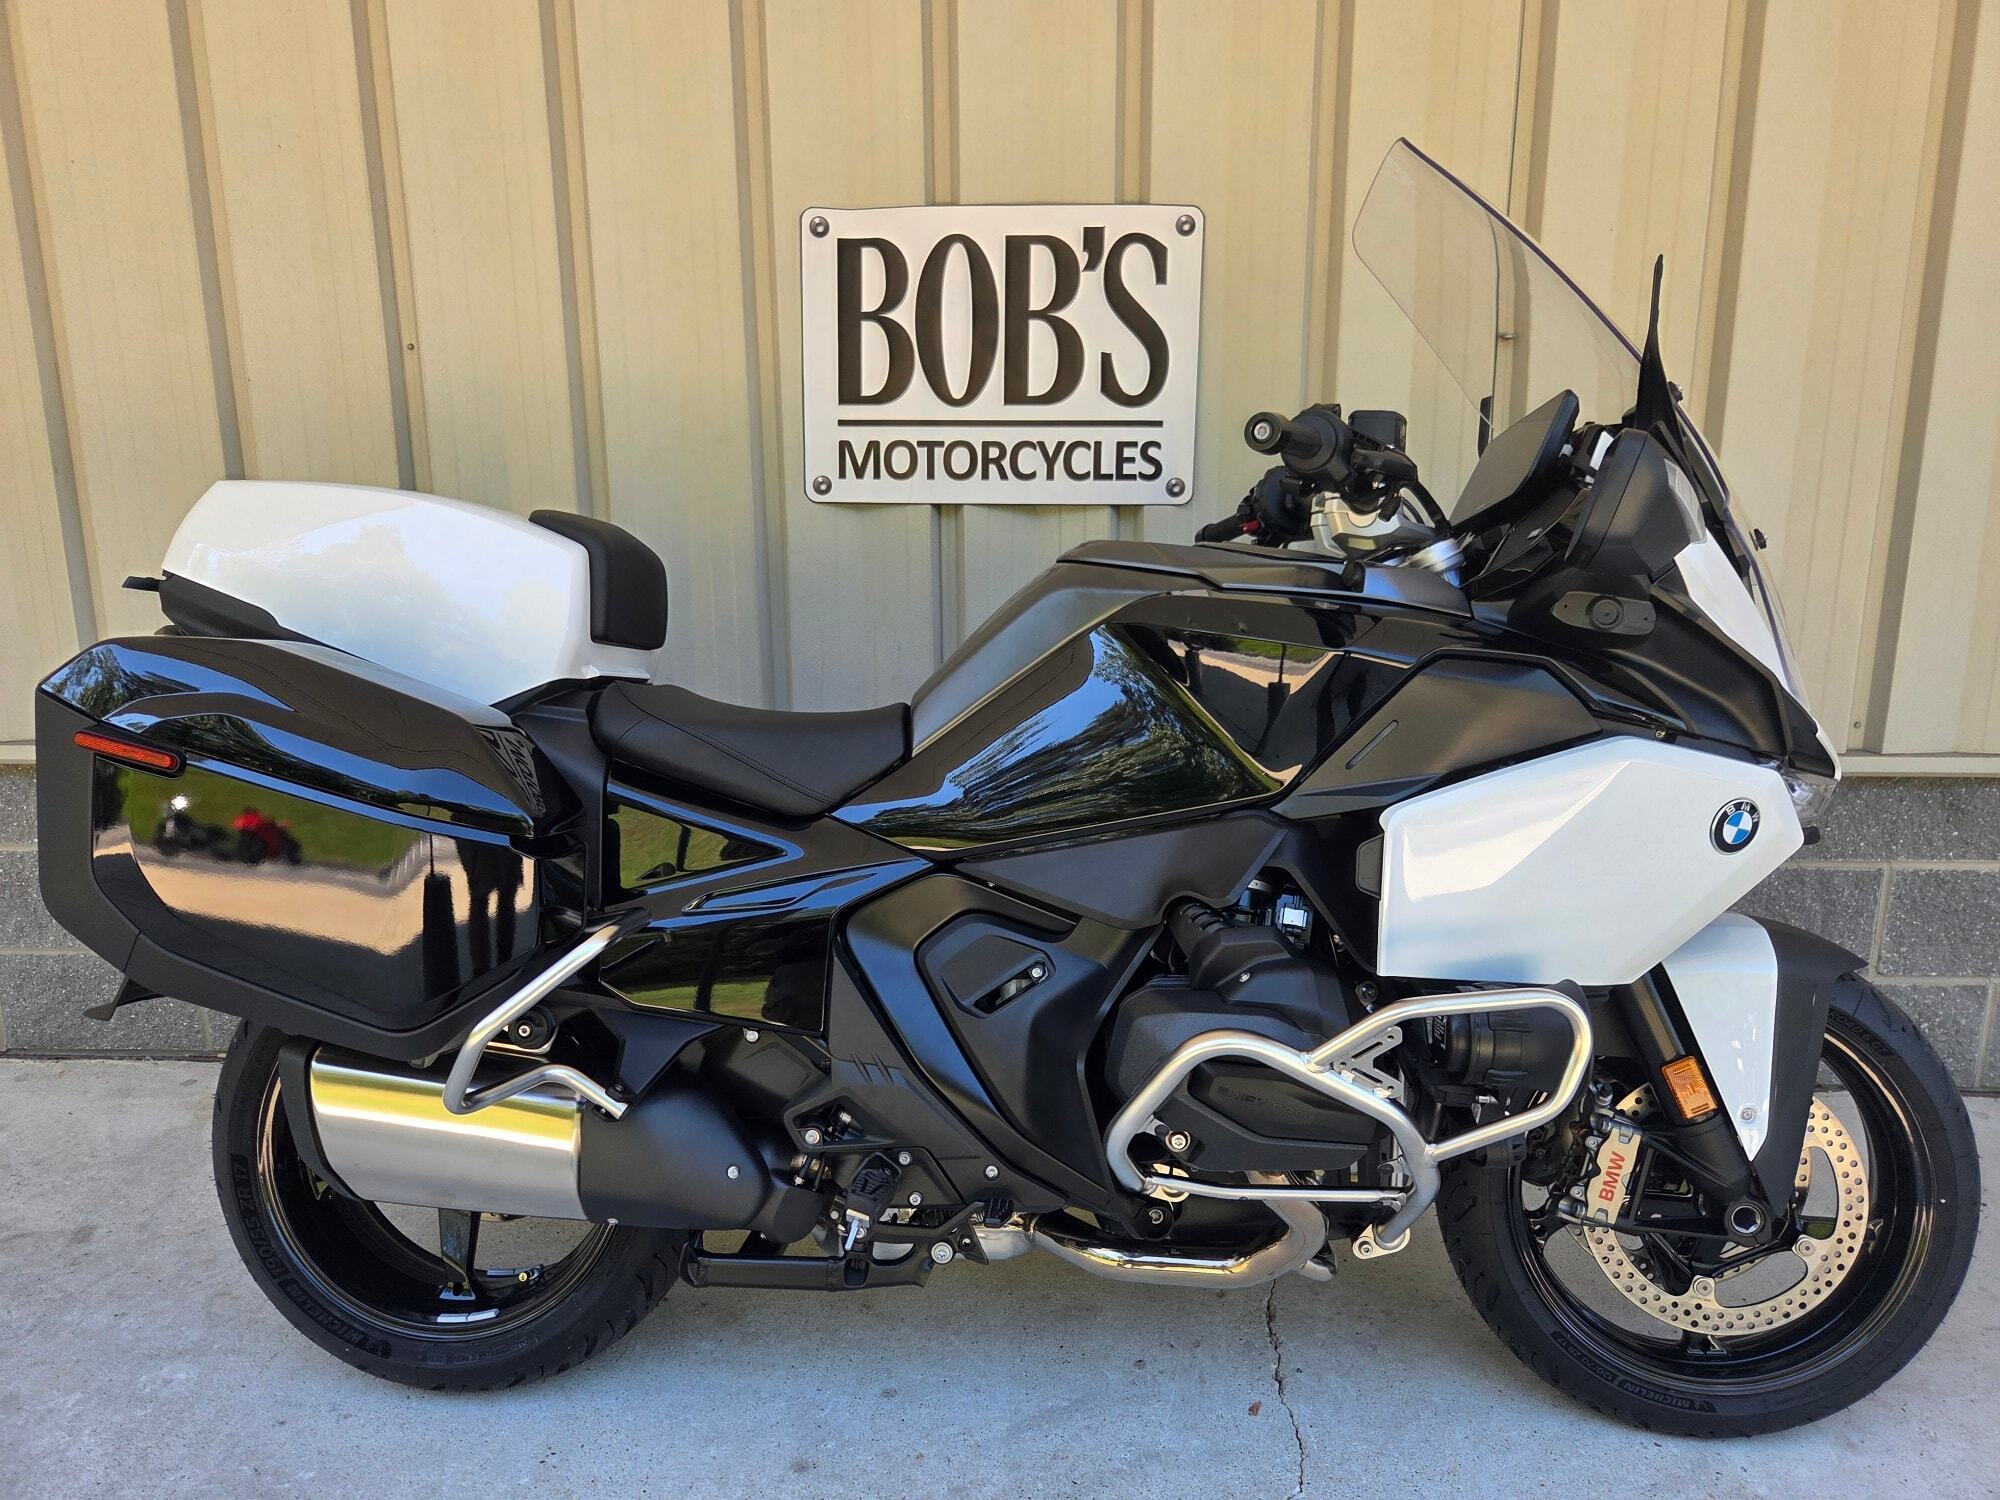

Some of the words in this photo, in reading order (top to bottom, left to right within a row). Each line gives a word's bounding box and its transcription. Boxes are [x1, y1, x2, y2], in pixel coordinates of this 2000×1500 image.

[837, 226, 1169, 408] BOB'S
[837, 439, 1163, 481] MOTORCYCLES
[1725, 801, 1760, 823] BMW
[1599, 1151, 1626, 1201] BMW
[1568, 1347, 1582, 1358] ZR
[1582, 1357, 1615, 1381] 120/70
[1625, 1382, 1690, 1407] MICHELIN
